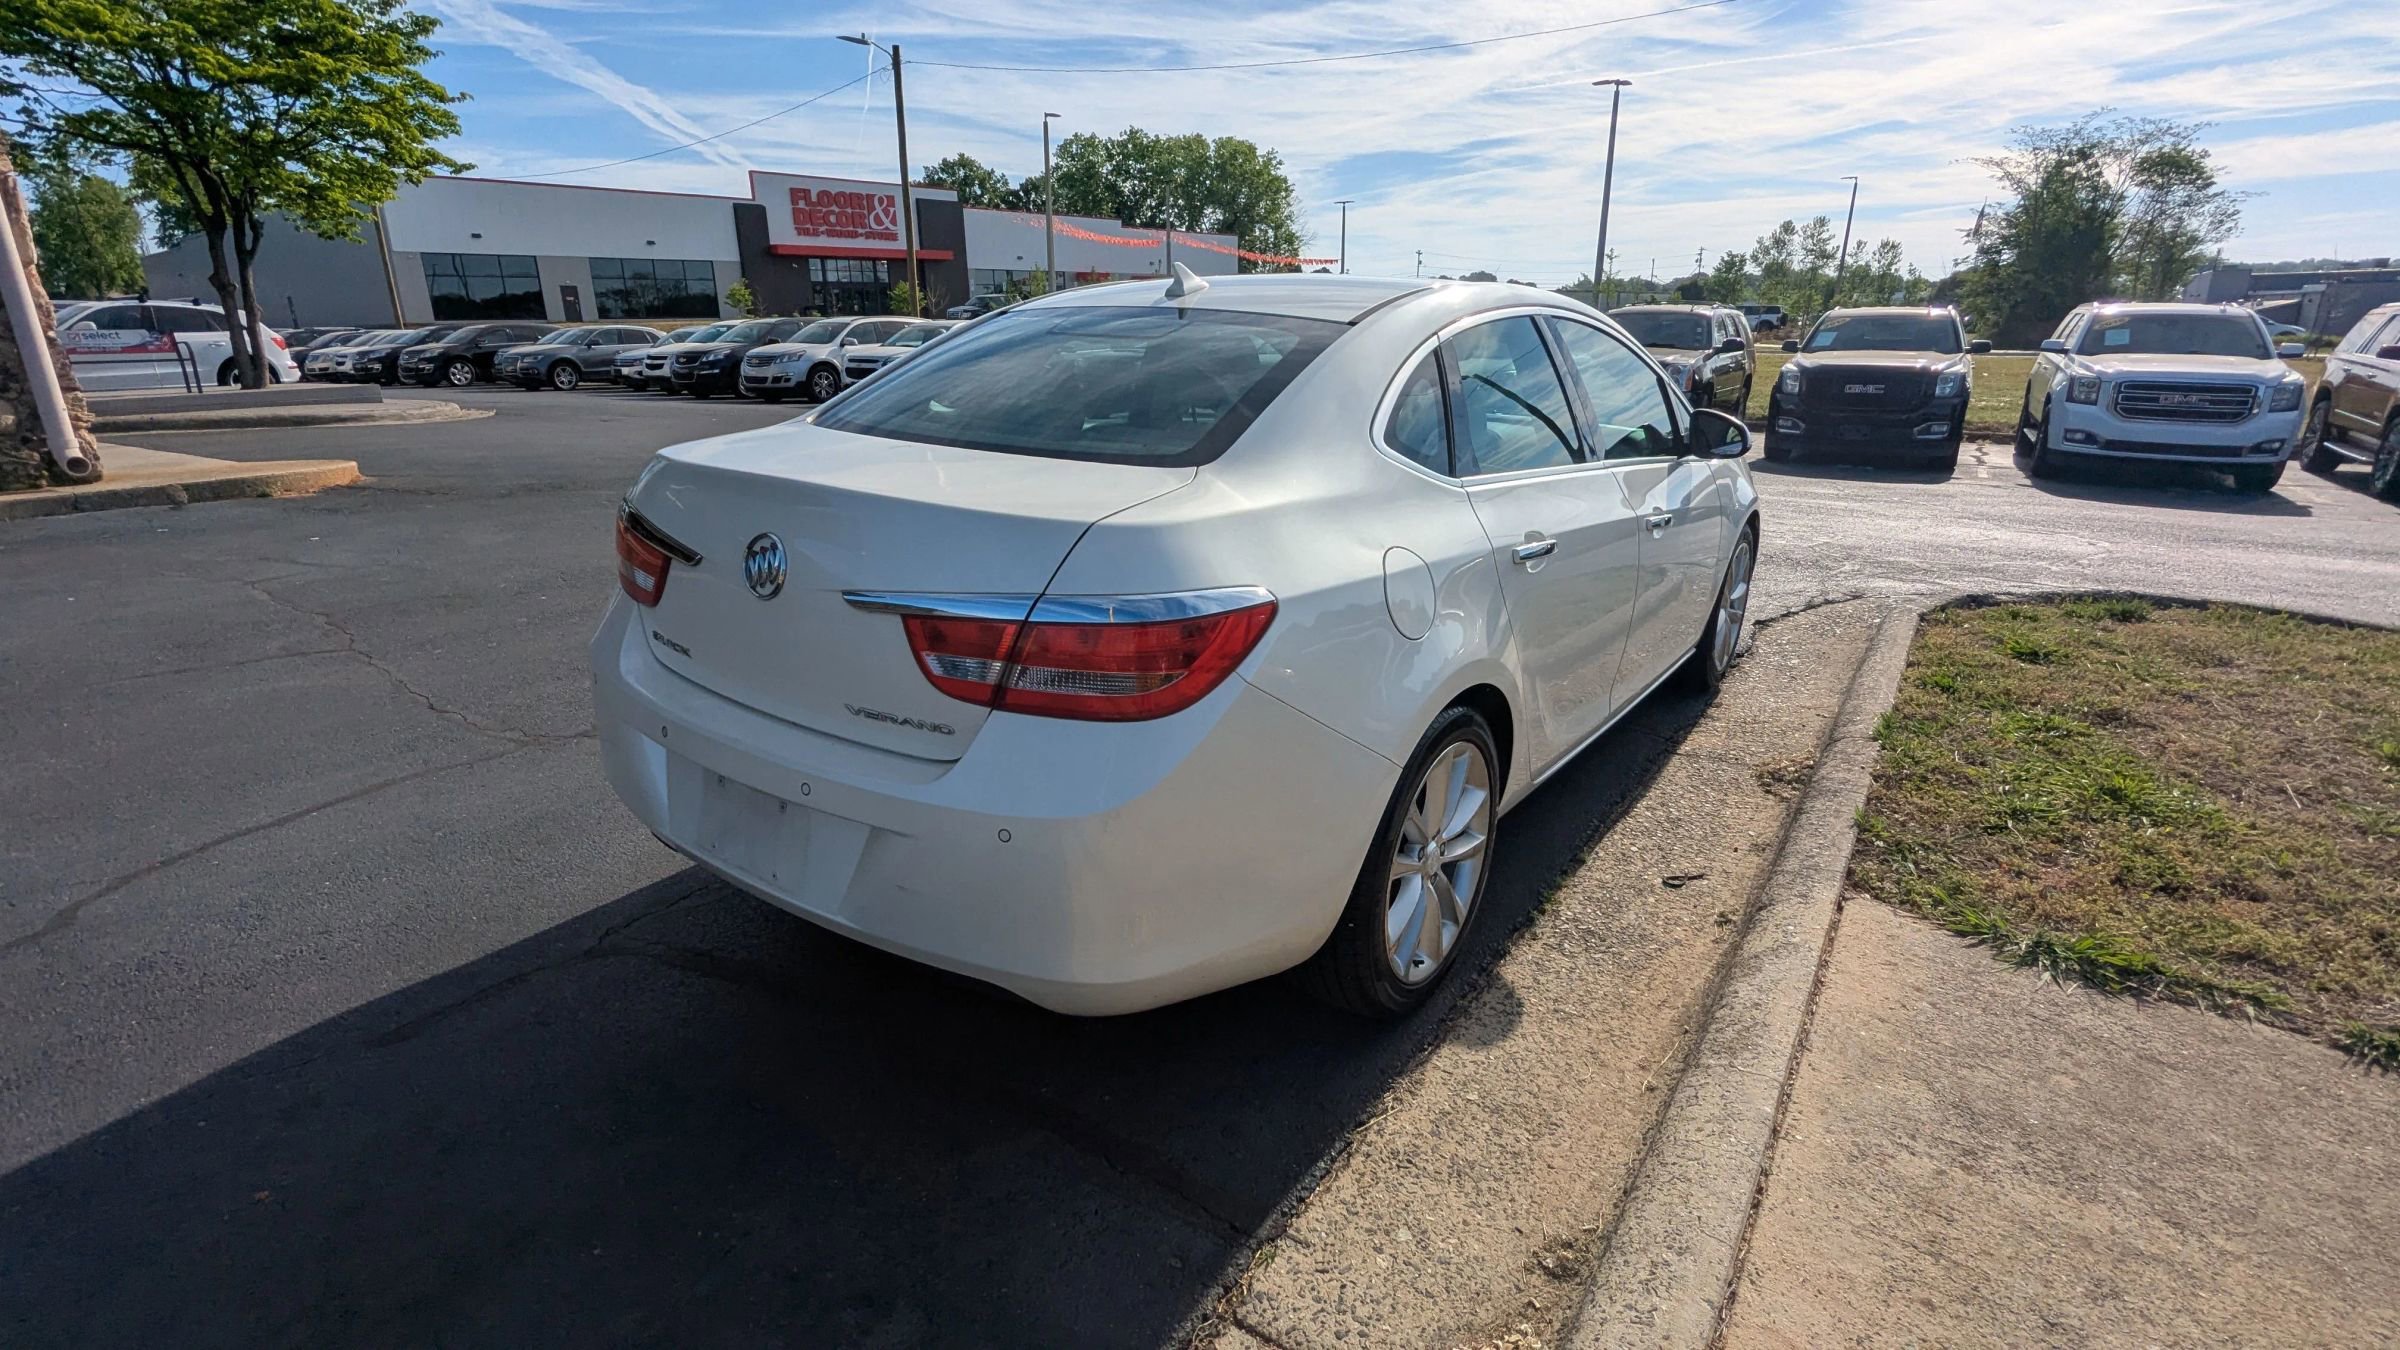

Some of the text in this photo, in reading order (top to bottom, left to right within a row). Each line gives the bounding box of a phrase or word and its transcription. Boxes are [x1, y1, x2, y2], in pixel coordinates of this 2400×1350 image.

[789, 187, 899, 230] FLOOR &
[792, 207, 868, 229] DECOR
[81, 331, 121, 340] select
[1844, 384, 1885, 394] GMC
[2159, 394, 2210, 407] GMC
[844, 703, 956, 735] VERANO
